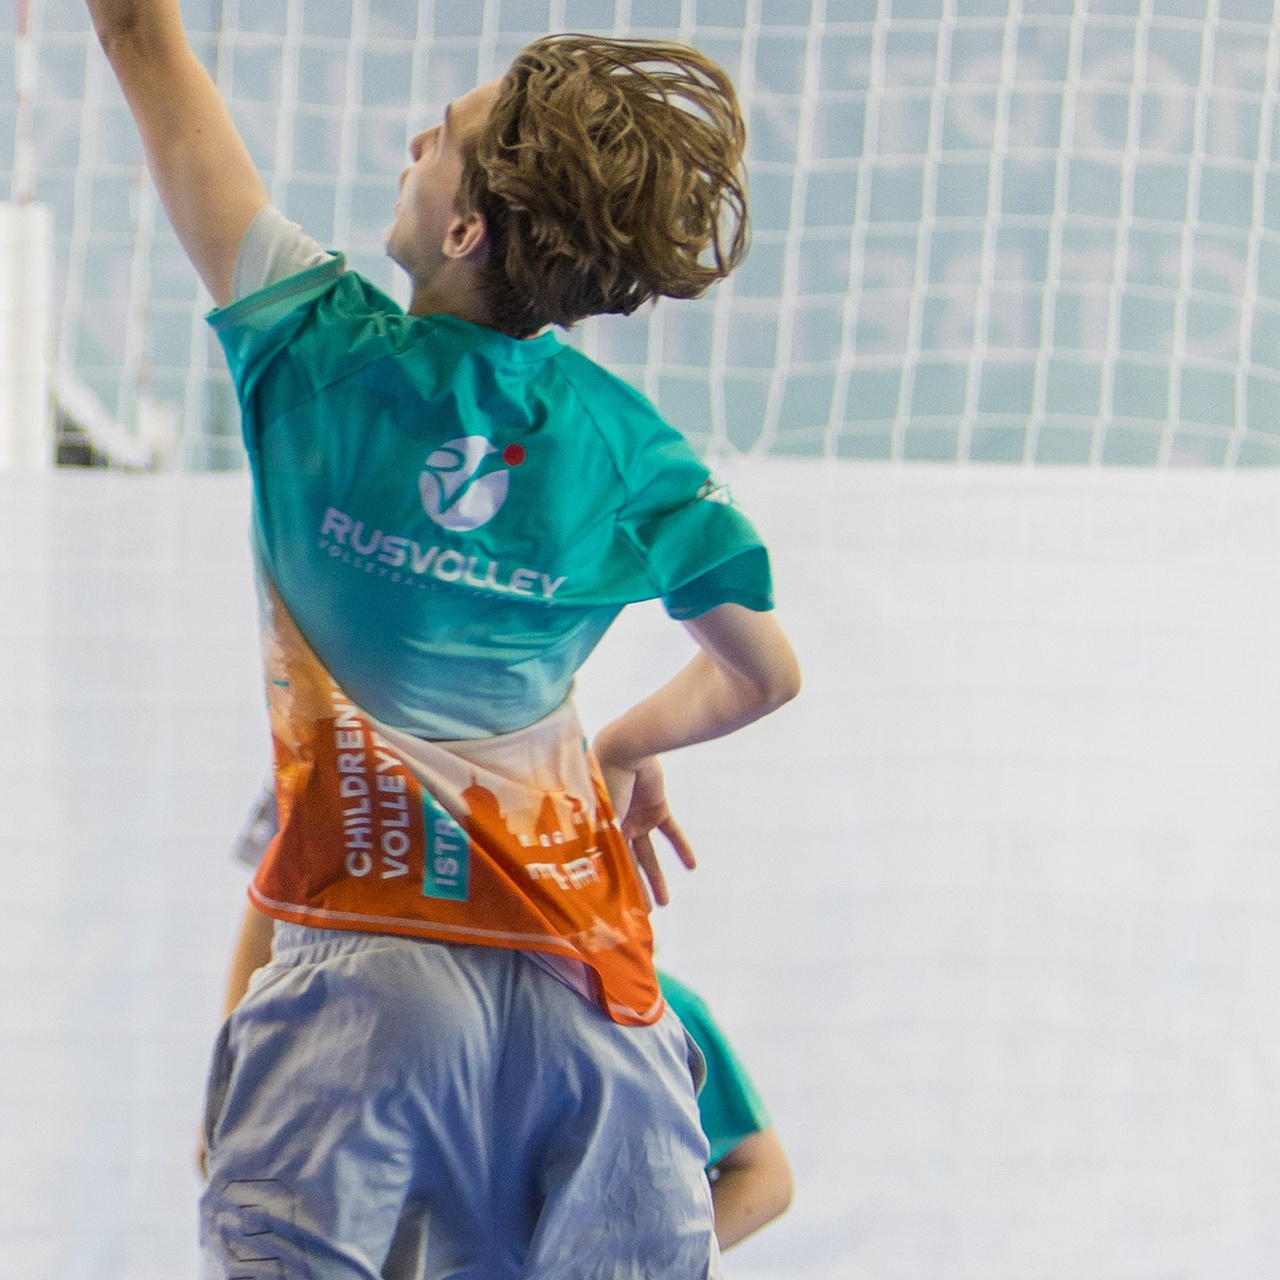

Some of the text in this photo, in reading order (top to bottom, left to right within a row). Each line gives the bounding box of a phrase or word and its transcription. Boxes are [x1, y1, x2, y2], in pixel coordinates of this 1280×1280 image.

[320, 506, 568, 600] RUSVOLLEY
[332, 690, 373, 878] CHILDREN
[433, 802, 461, 886] ISTR
